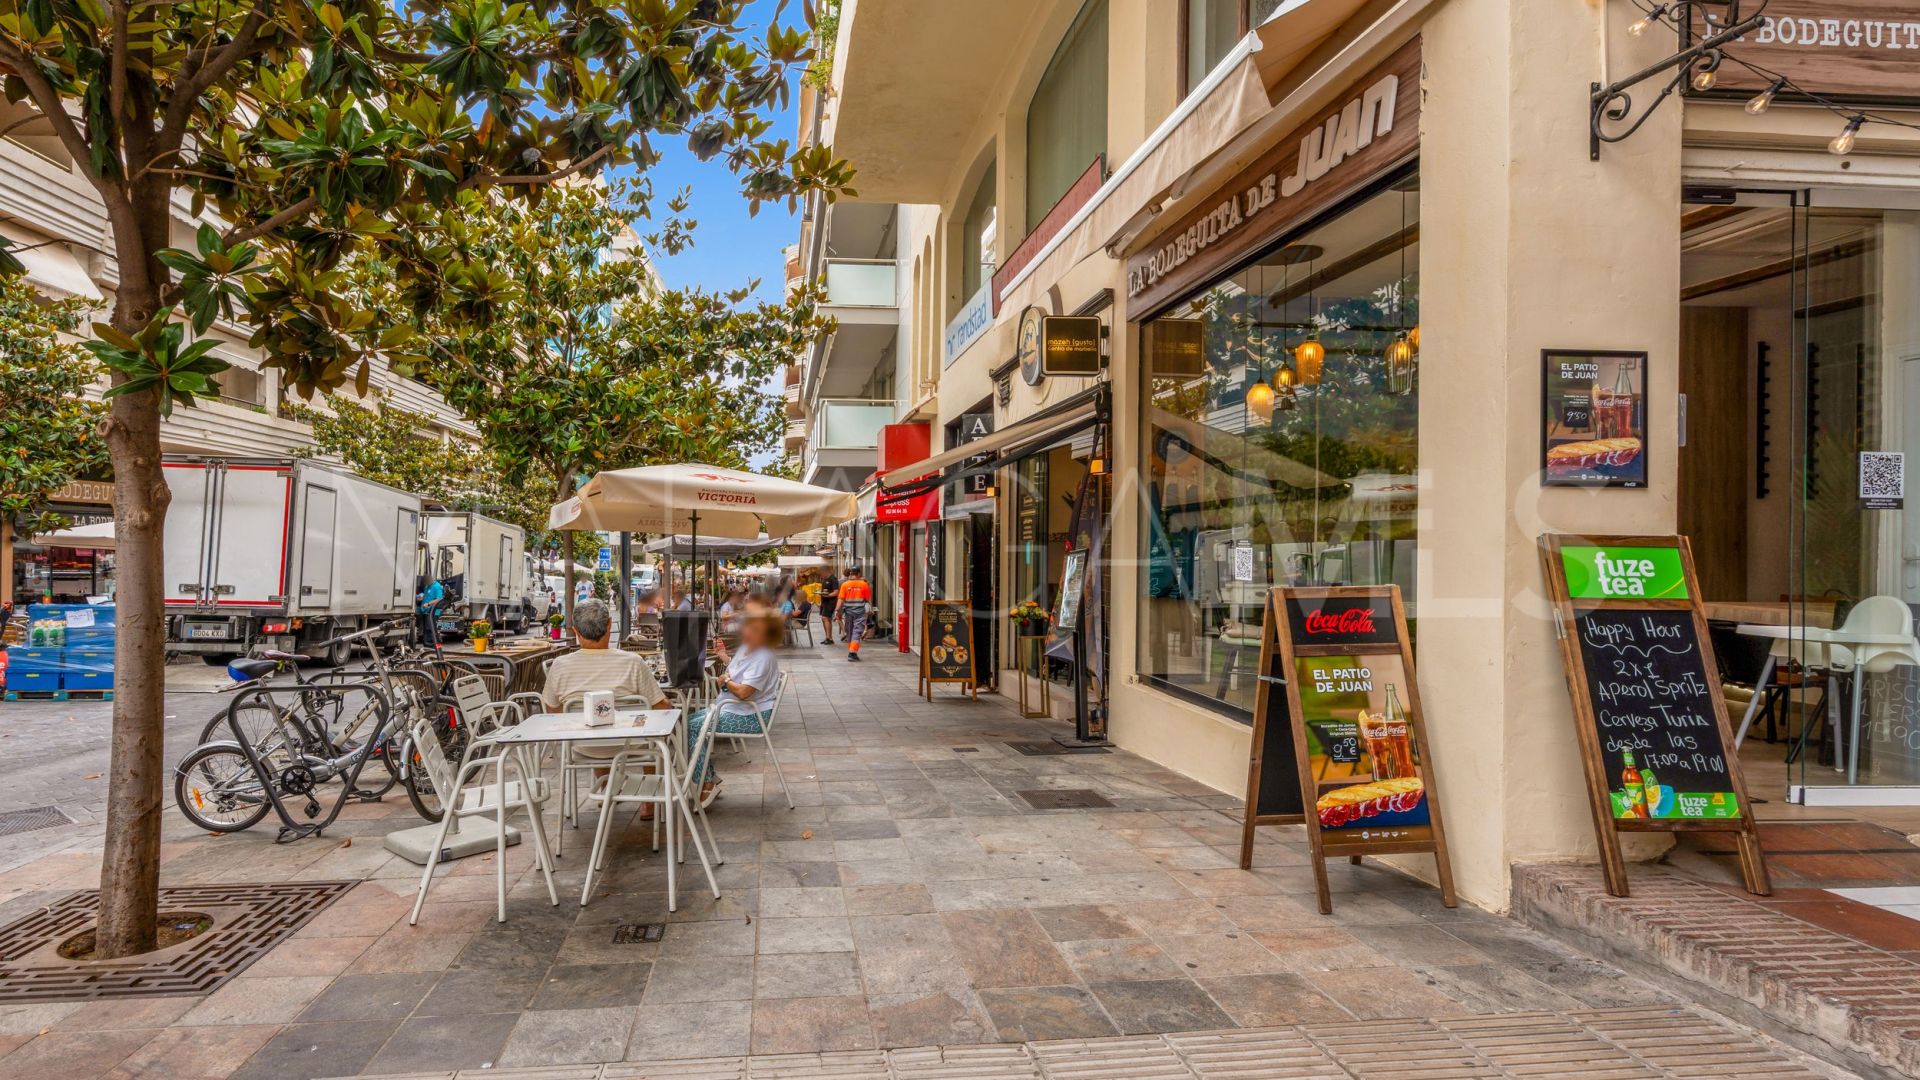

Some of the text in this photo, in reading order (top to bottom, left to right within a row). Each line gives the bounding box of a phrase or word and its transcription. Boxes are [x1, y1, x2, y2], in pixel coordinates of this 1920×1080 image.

[1702, 15, 1744, 41] L
[1128, 266, 1149, 298] LA
[1148, 195, 1243, 285] BODEGUITA
[1246, 174, 1276, 217] DE
[957, 292, 987, 348] randstad
[1561, 363, 1599, 371] EL PATIO
[1562, 371, 1598, 380] DE JUAN
[698, 492, 756, 505] VICTORIA
[73, 515, 86, 526] LA
[1594, 551, 1656, 578] fuze
[1598, 576, 1645, 596] tea
[1306, 608, 1375, 634] Coca-Cola
[1585, 616, 1681, 643] Happy Hour
[1312, 668, 1372, 680] EL PATIO
[1316, 681, 1373, 693] DE JUAN
[1600, 709, 1659, 732] Cerveza
[1607, 731, 1698, 752] desde las
[1680, 760, 1692, 770] a
[1678, 793, 1708, 807] fuze
[1681, 805, 1704, 816] tea
